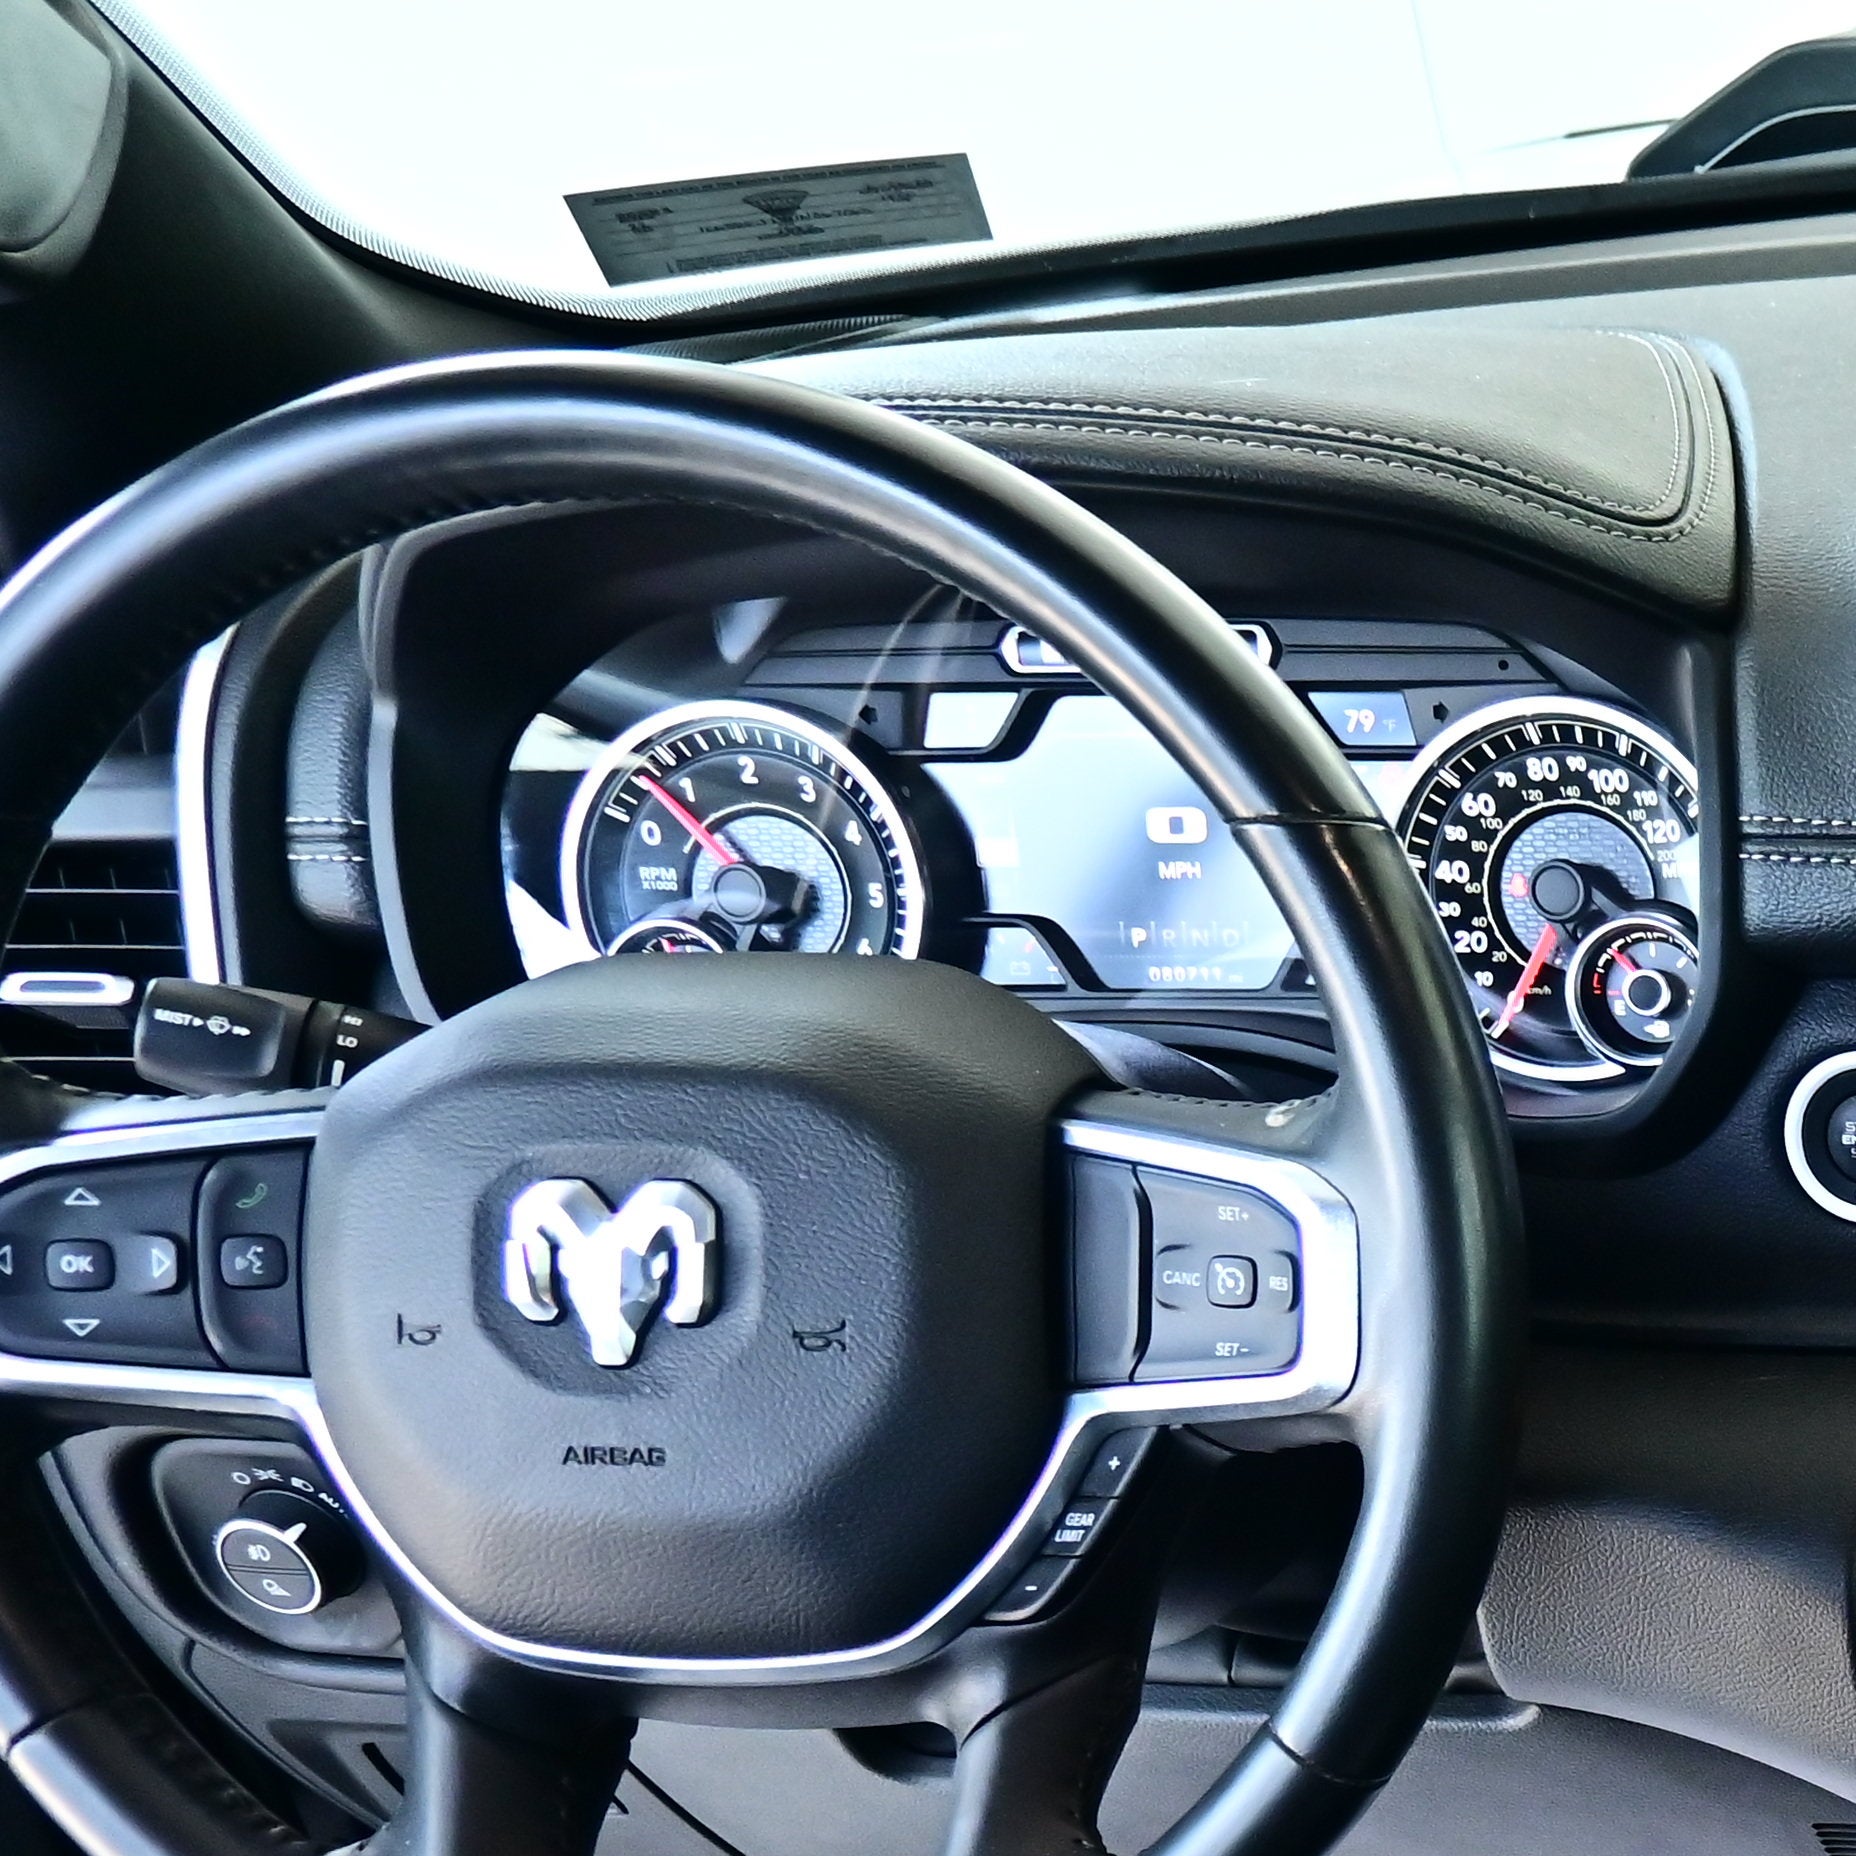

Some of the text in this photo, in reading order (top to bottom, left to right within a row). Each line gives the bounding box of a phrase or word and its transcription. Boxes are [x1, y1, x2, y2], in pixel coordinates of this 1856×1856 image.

[1344, 709, 1376, 734] 79
[737, 756, 759, 784] 2
[1526, 756, 1560, 782] 80
[1565, 755, 1587, 773] 90
[798, 775, 817, 803] 3
[1494, 771, 1518, 789] 70
[1588, 768, 1629, 793] 100
[679, 777, 696, 803] 1
[1521, 788, 1544, 803] 120
[1560, 784, 1581, 798] 140
[1600, 792, 1621, 806] 160
[1633, 790, 1658, 806] 110
[1461, 791, 1496, 817] 60
[844, 819, 862, 846] 4
[1145, 806, 1208, 844] 0
[1480, 816, 1503, 831] 100
[1642, 819, 1681, 844] 120
[640, 820, 662, 847] 0
[1444, 825, 1468, 842] 50
[639, 866, 678, 881] RPM
[1158, 860, 1202, 880] MPH
[1434, 859, 1470, 885] 40
[868, 882, 885, 909] 5
[1464, 881, 1481, 895] 60
[1438, 901, 1461, 918] 30
[1453, 930, 1488, 954] 20
[1474, 970, 1494, 987] 10
[154, 1008, 193, 1026] MIST
[337, 1034, 358, 1048] LO
[60, 1254, 94, 1273] OK
[1162, 1269, 1200, 1286] CANC
[1269, 1276, 1288, 1292] RES
[561, 1446, 666, 1466] AIRBAG
[1065, 1512, 1095, 1527] GEAR
[1054, 1528, 1086, 1543] LIMIT
